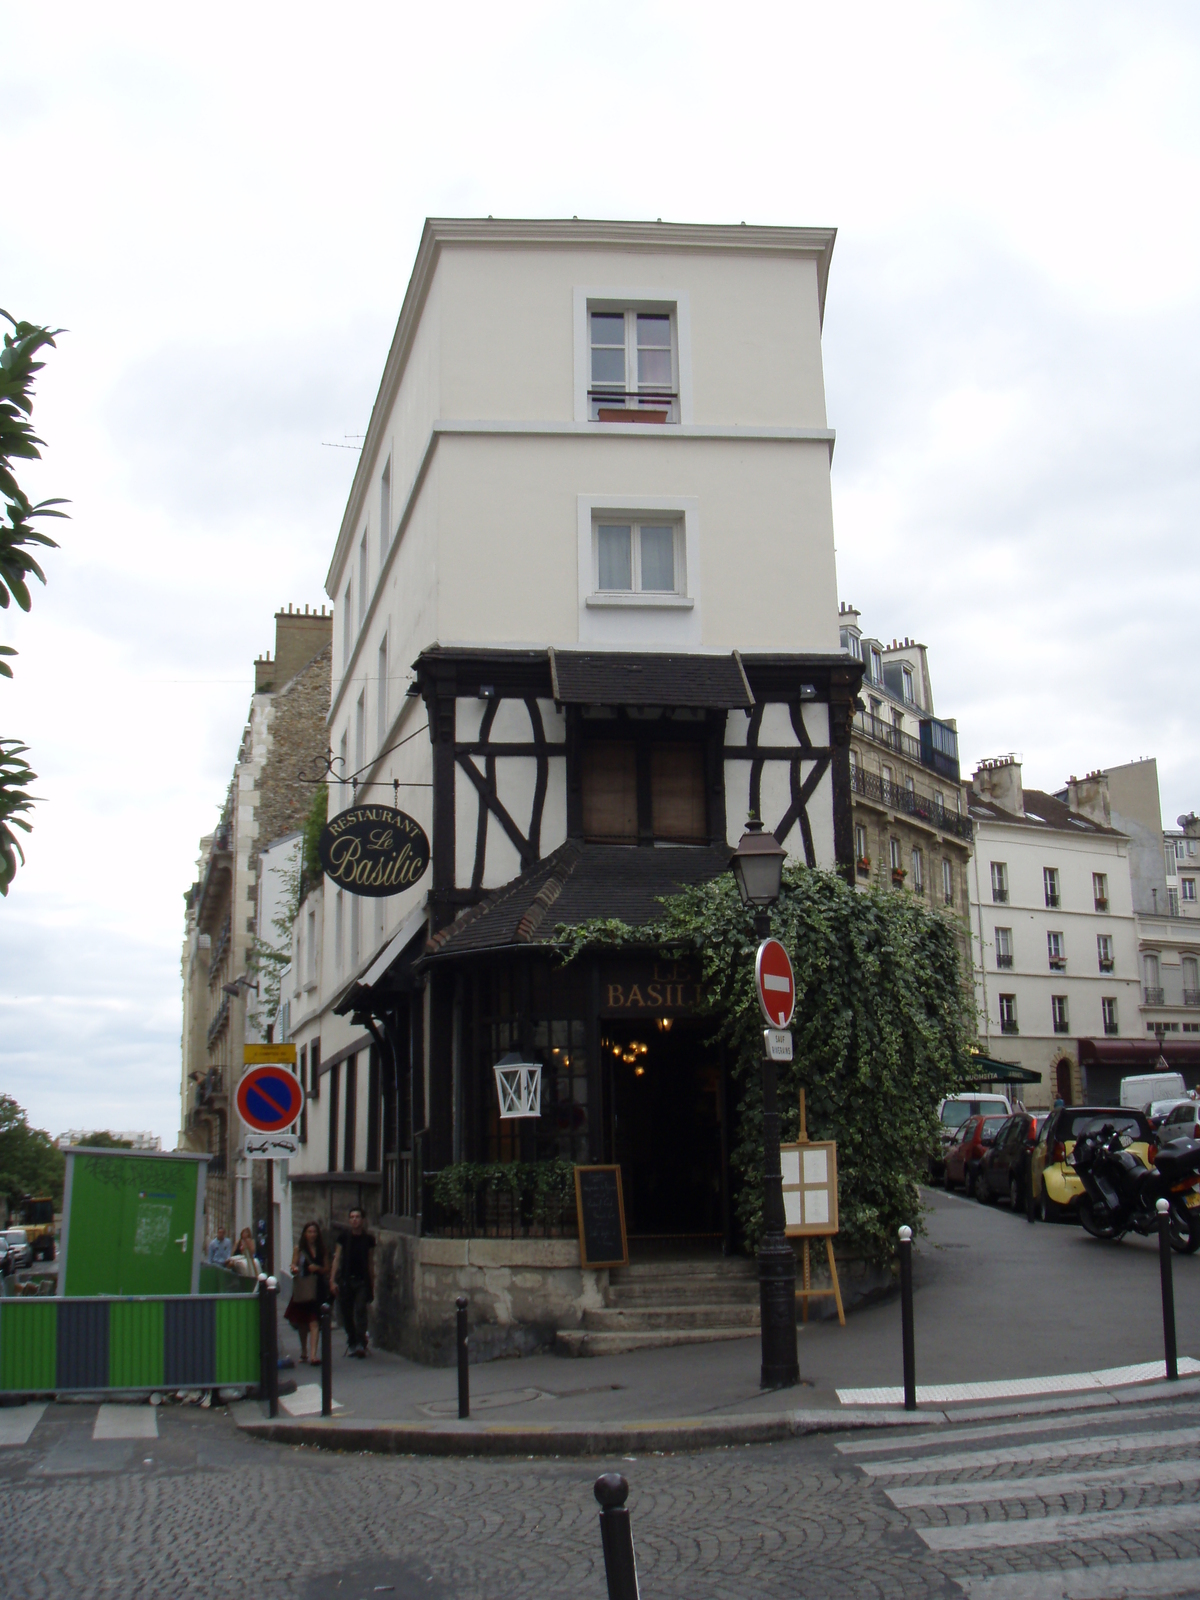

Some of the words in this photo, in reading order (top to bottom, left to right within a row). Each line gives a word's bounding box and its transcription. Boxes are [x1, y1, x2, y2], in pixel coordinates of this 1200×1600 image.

[328, 809, 421, 837] RESTAURANT
[367, 829, 394, 850] Le
[327, 836, 424, 885] Basilic
[652, 962, 691, 982] LE
[607, 983, 712, 1007] BASILI
